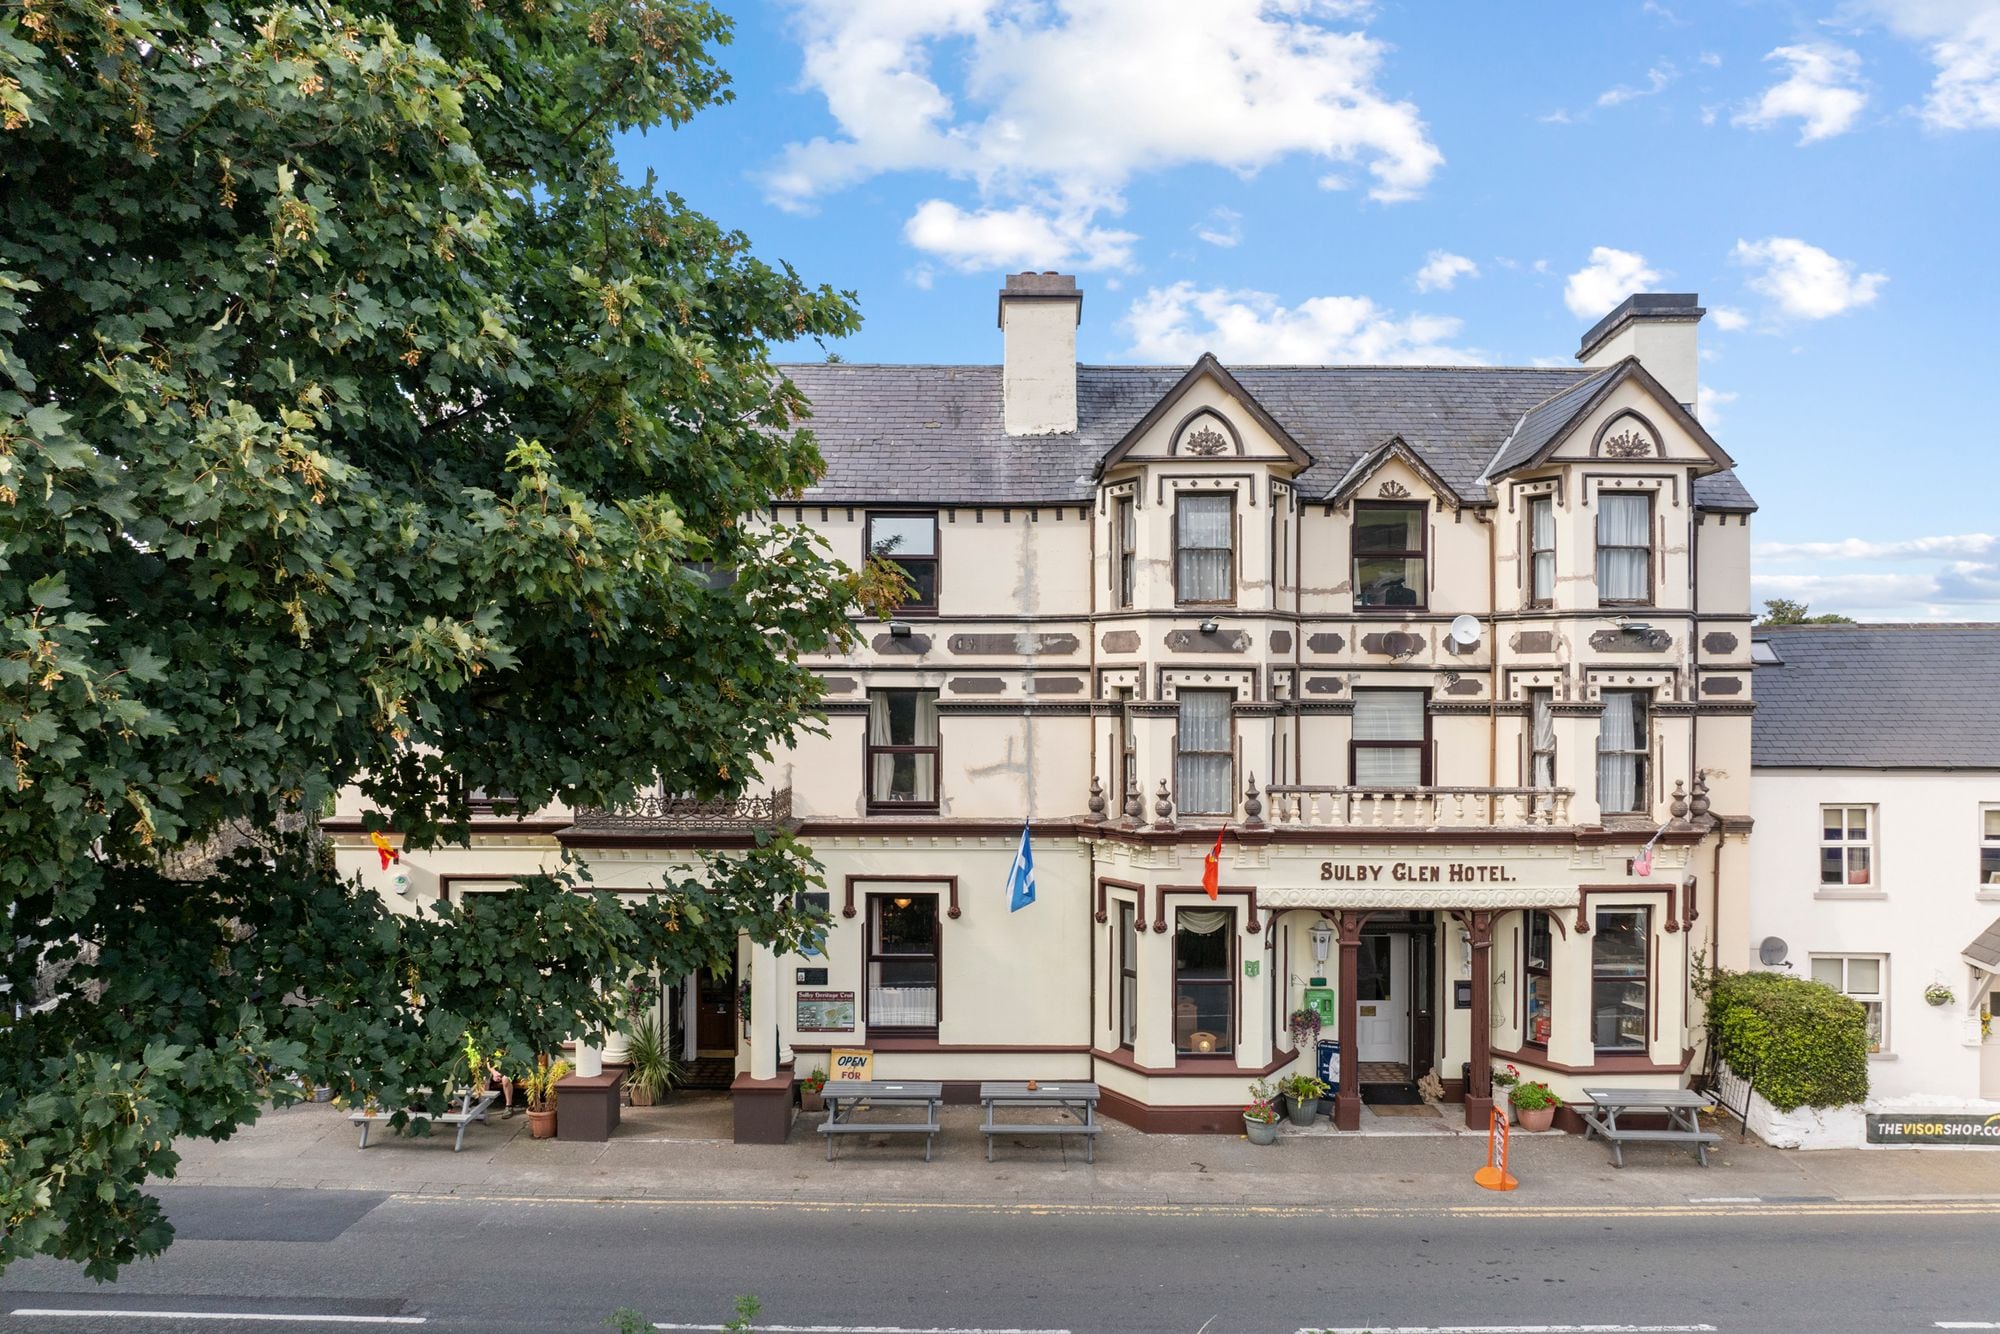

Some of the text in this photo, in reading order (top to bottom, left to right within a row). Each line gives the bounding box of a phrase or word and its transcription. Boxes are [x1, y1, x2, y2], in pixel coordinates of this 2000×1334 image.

[1320, 861, 1516, 882] SULBY GLEN HOTEL.
[838, 1056, 867, 1067] OPEN
[841, 1071, 861, 1080] FOR
